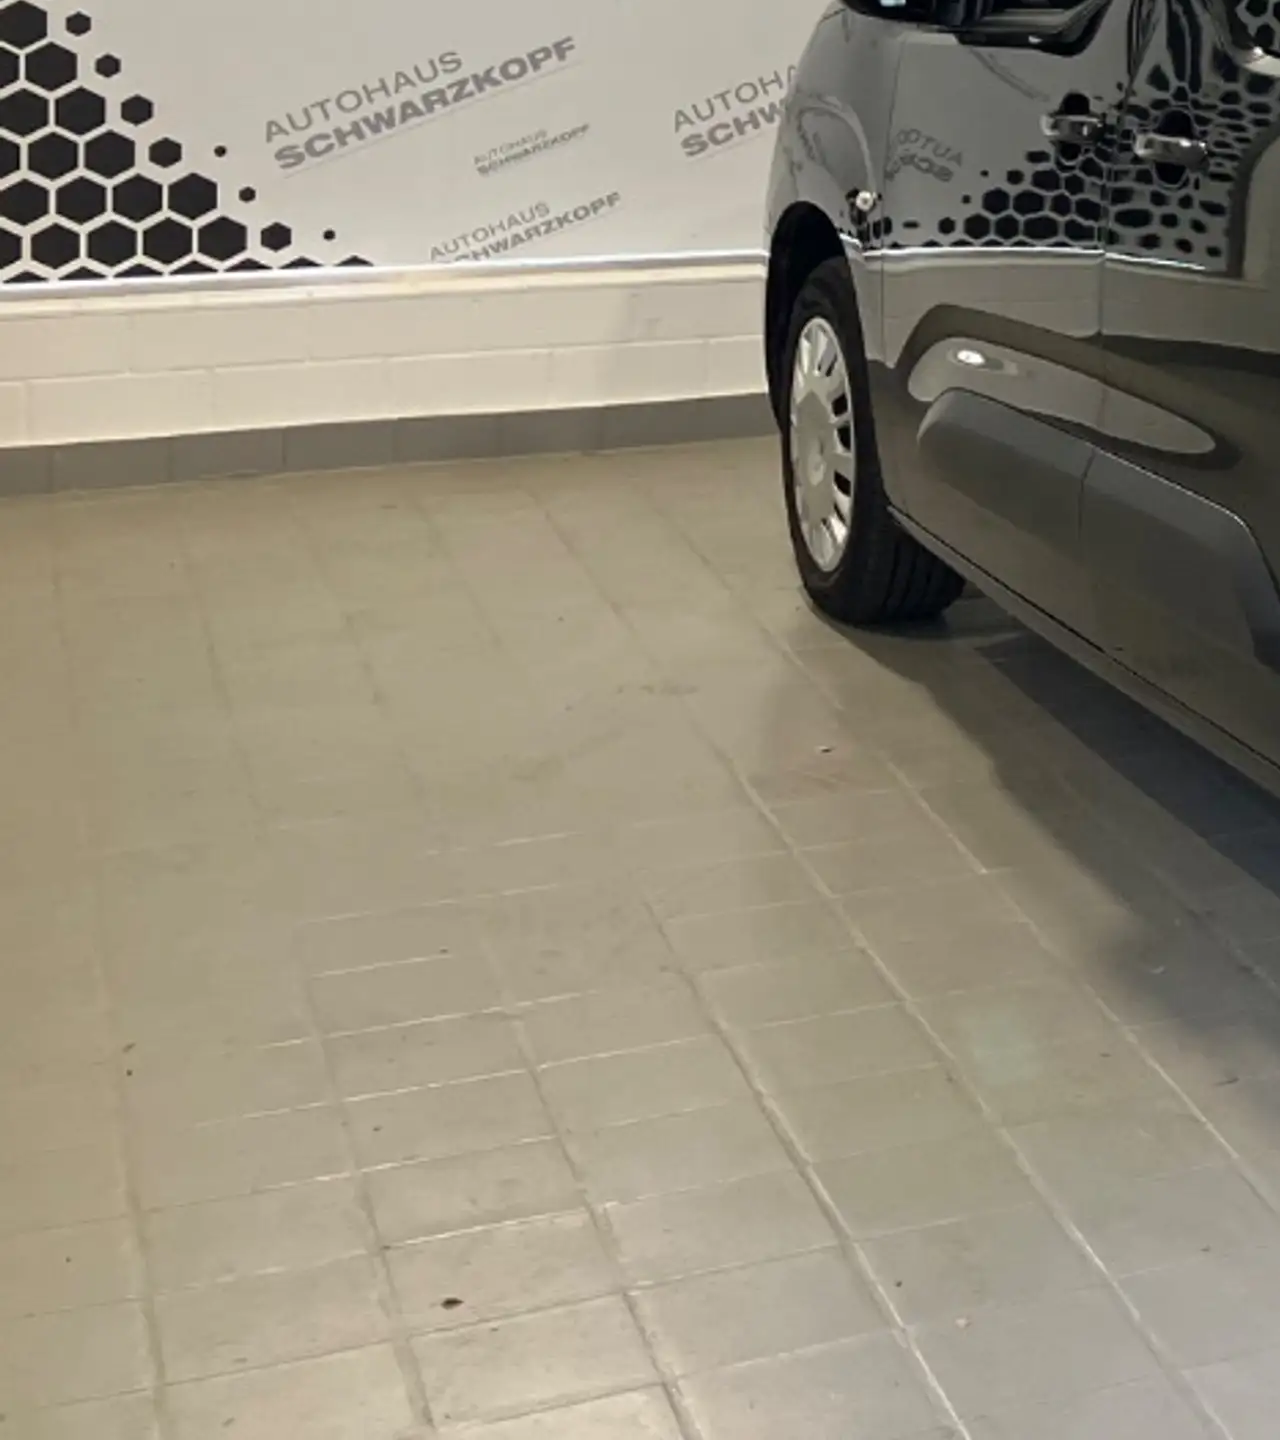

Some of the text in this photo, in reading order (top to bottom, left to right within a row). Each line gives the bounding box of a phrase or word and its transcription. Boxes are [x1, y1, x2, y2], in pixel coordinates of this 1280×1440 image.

[265, 51, 463, 143] AUTOHAUS
[274, 36, 575, 170] SCHWARZKOPF
[674, 65, 796, 133] AUTOH
[430, 201, 550, 261] AUTOHAUS
